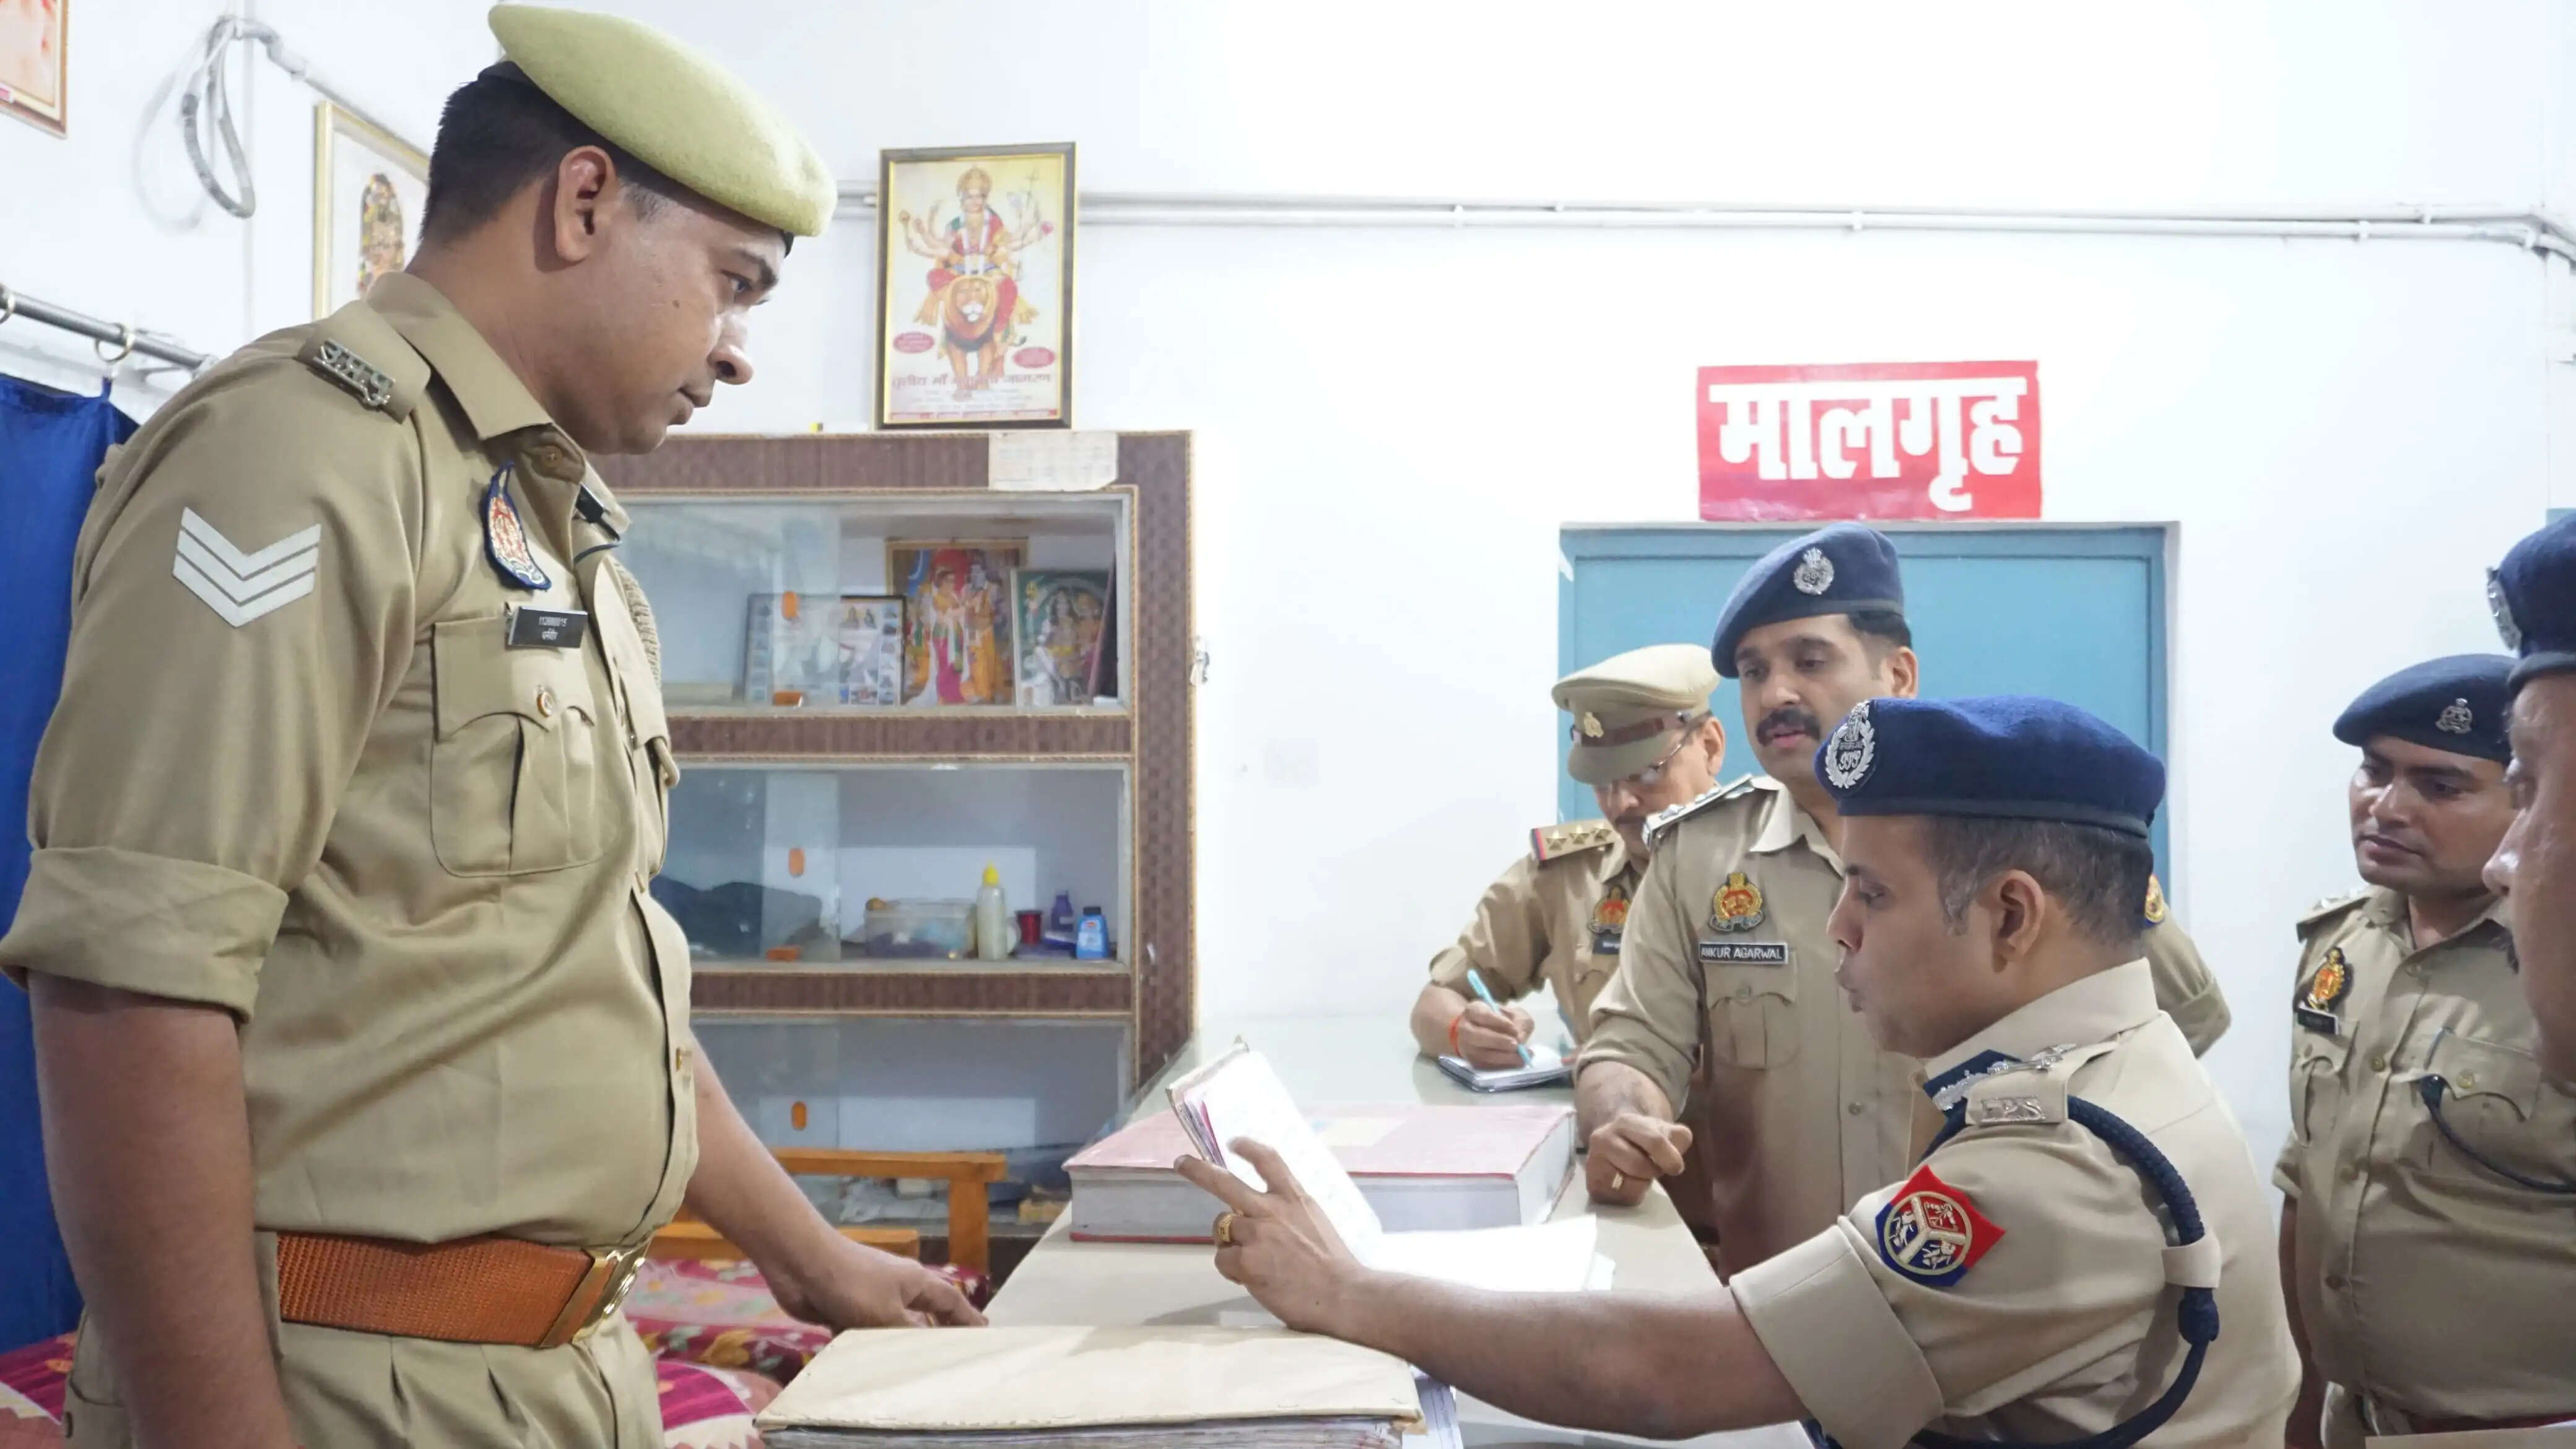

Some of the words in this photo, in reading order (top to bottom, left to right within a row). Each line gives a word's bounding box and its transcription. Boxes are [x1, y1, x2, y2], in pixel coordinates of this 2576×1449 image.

[1708, 376, 2027, 512] मालगृह
[1701, 947, 1731, 959] ANKUR
[1733, 947, 1783, 960] AGARWAL
